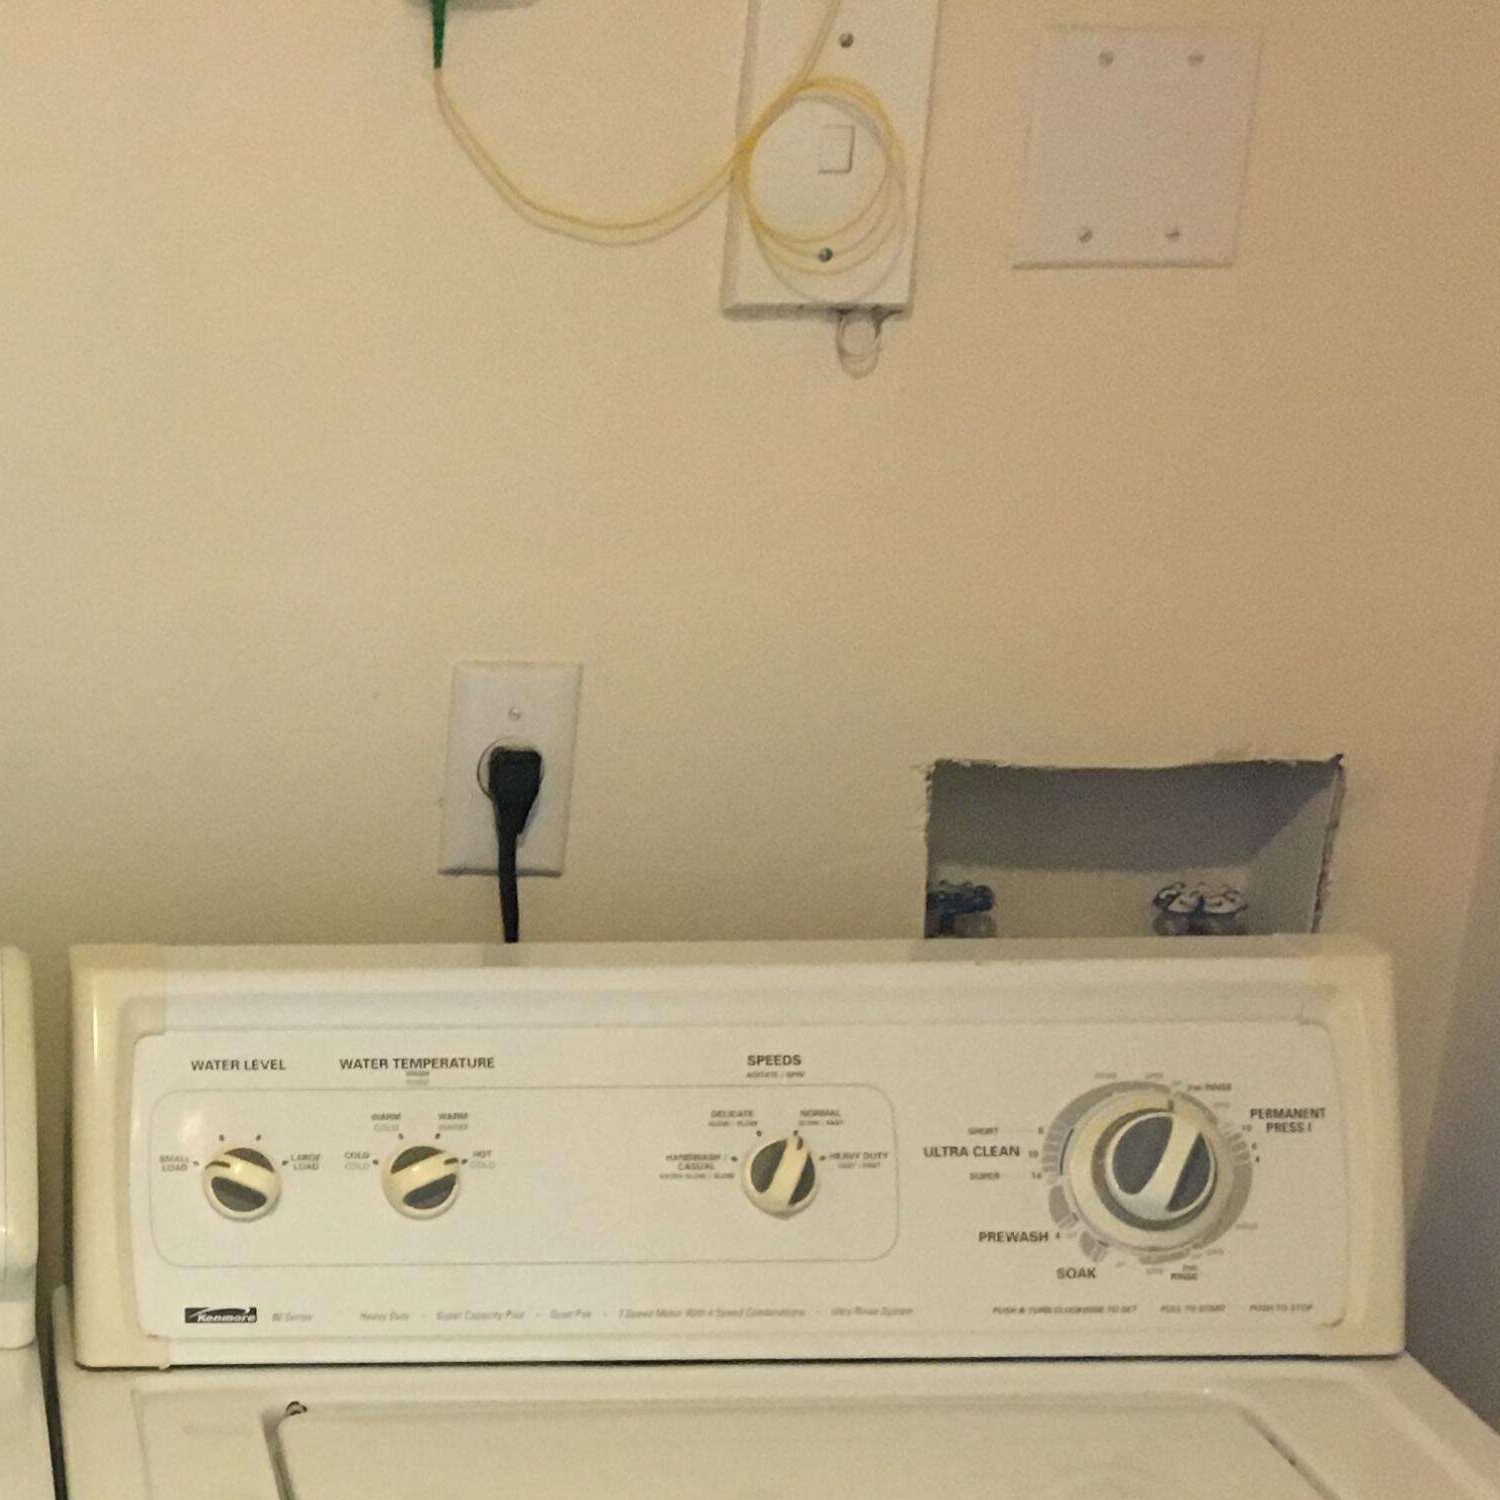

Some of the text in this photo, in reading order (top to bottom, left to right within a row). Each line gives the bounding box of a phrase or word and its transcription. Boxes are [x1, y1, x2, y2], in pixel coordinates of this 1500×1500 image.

[191, 1058, 287, 1071] WATER LEVEL
[339, 1057, 495, 1069] WATER TEMPERATURE
[747, 1054, 802, 1066] SPEEDS
[1249, 1107, 1326, 1119] PERMANENT
[1265, 1121, 1305, 1133] PRESS
[343, 1150, 370, 1159] COLD
[863, 1150, 889, 1160] DUTY
[923, 1145, 969, 1157] ULTRA
[972, 1145, 1020, 1157] CLEAN
[161, 1163, 188, 1172] LOAD
[344, 1162, 370, 1171] COLD
[978, 1230, 1049, 1243] PREWASH
[1056, 1266, 1097, 1280] SOAK
